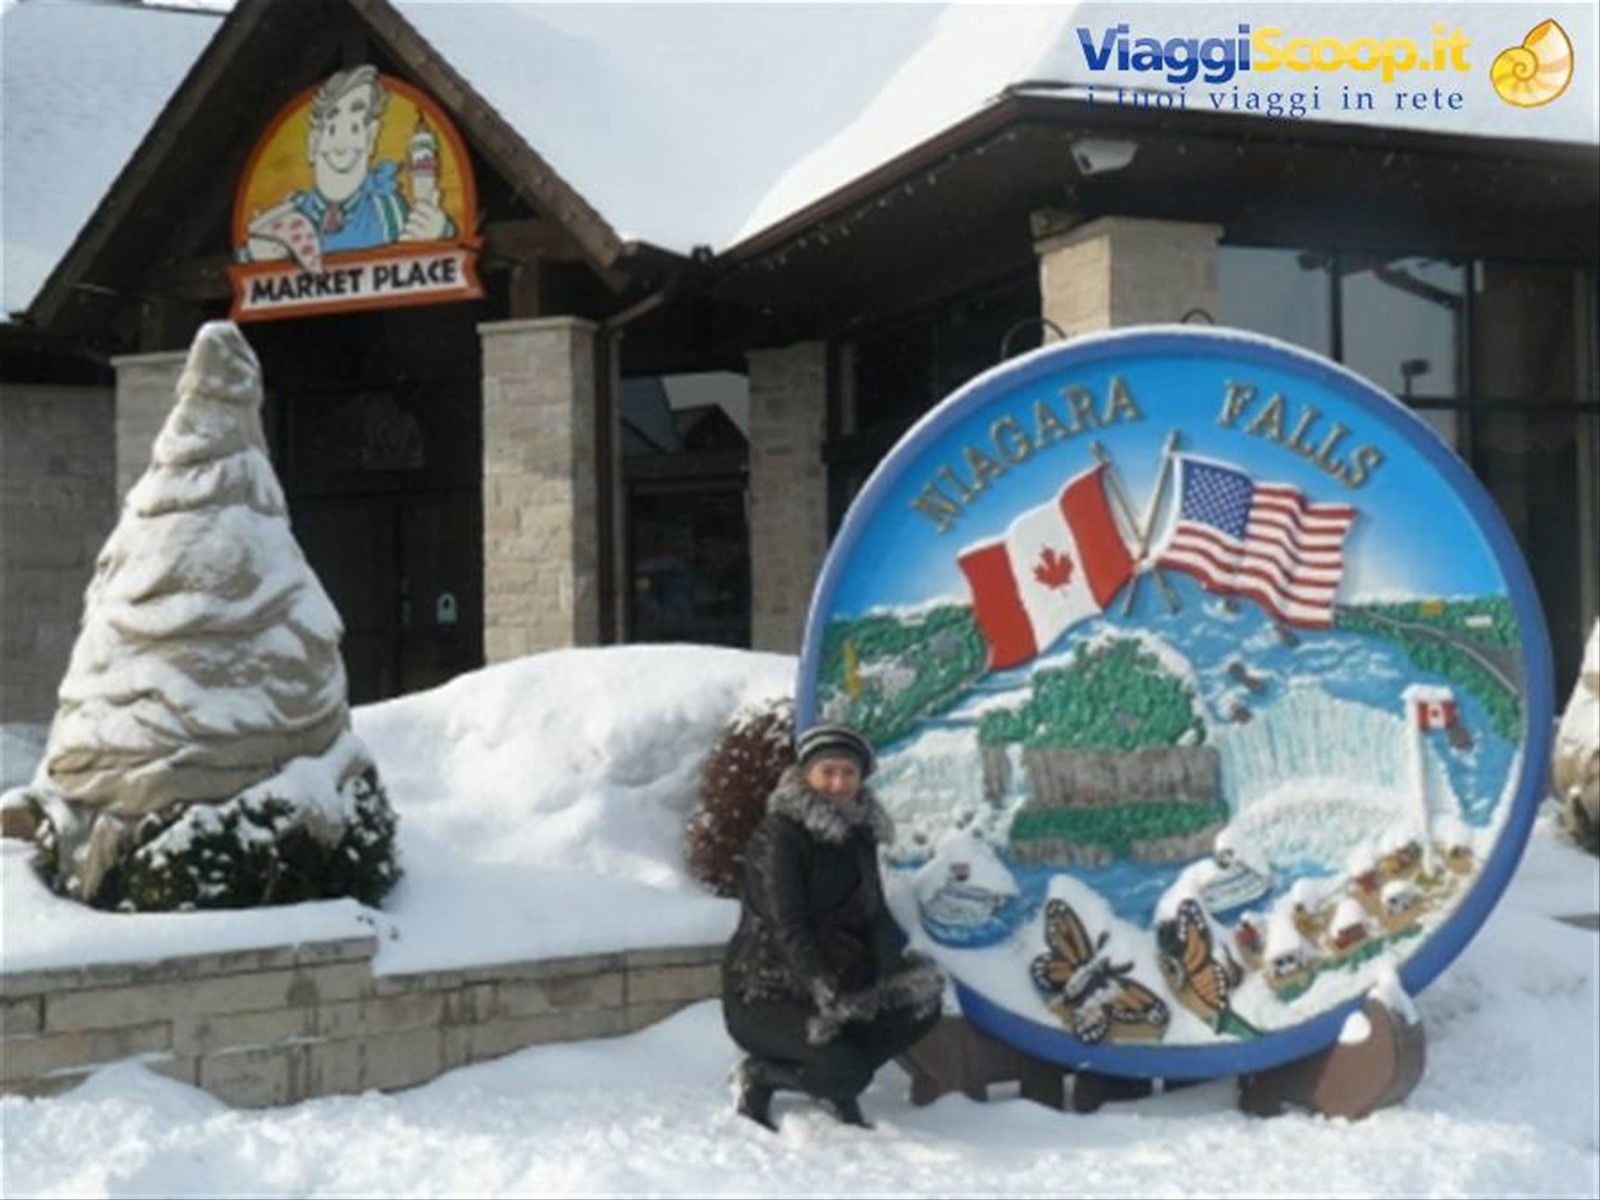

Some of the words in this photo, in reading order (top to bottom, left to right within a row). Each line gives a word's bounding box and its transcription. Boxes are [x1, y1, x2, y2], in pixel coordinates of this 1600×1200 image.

[251, 268, 363, 302] MARKET
[373, 257, 456, 290] PLACE
[911, 375, 1143, 534] NIAGARA
[1217, 379, 1385, 490] FALLS
